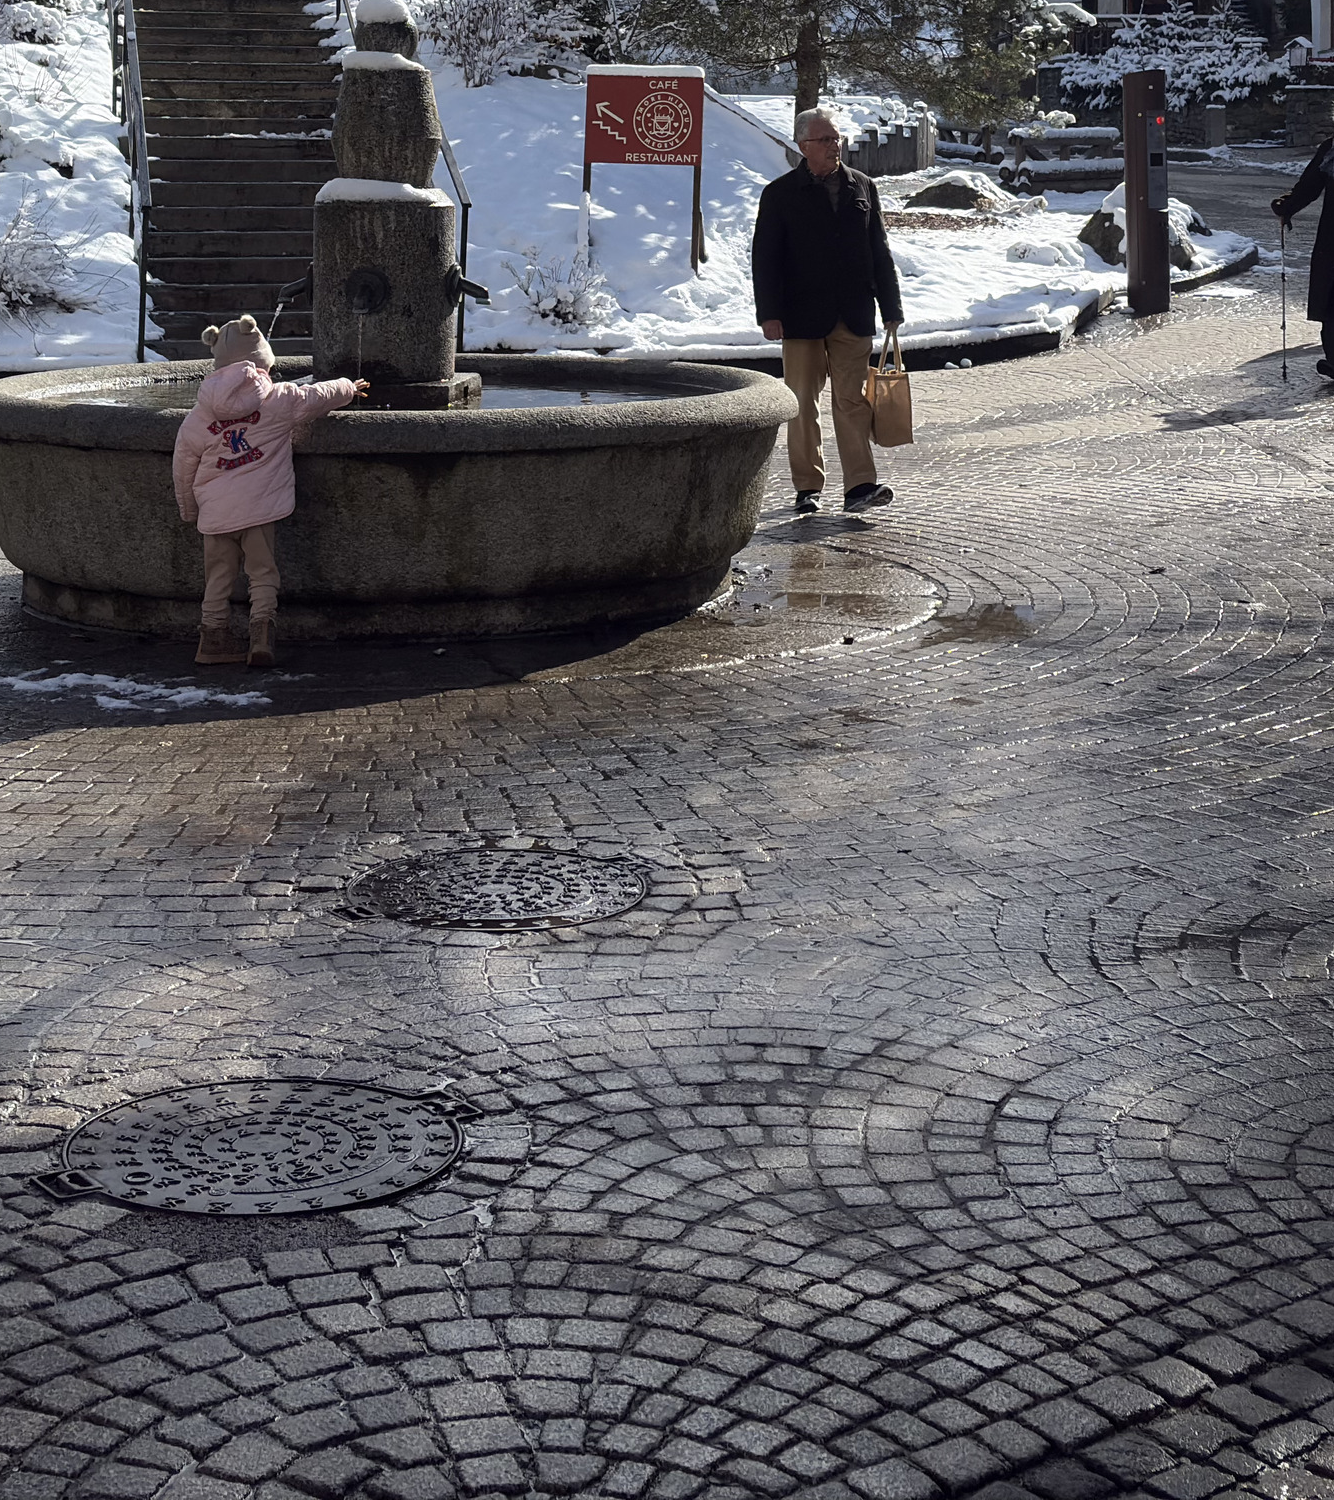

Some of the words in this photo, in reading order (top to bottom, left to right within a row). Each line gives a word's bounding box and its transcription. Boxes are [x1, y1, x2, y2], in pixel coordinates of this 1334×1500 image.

[649, 79, 679, 90] CAFÉ
[636, 95, 662, 121] AMORE
[668, 96, 690, 123] HIBOU
[625, 153, 699, 163] RESTAURANT
